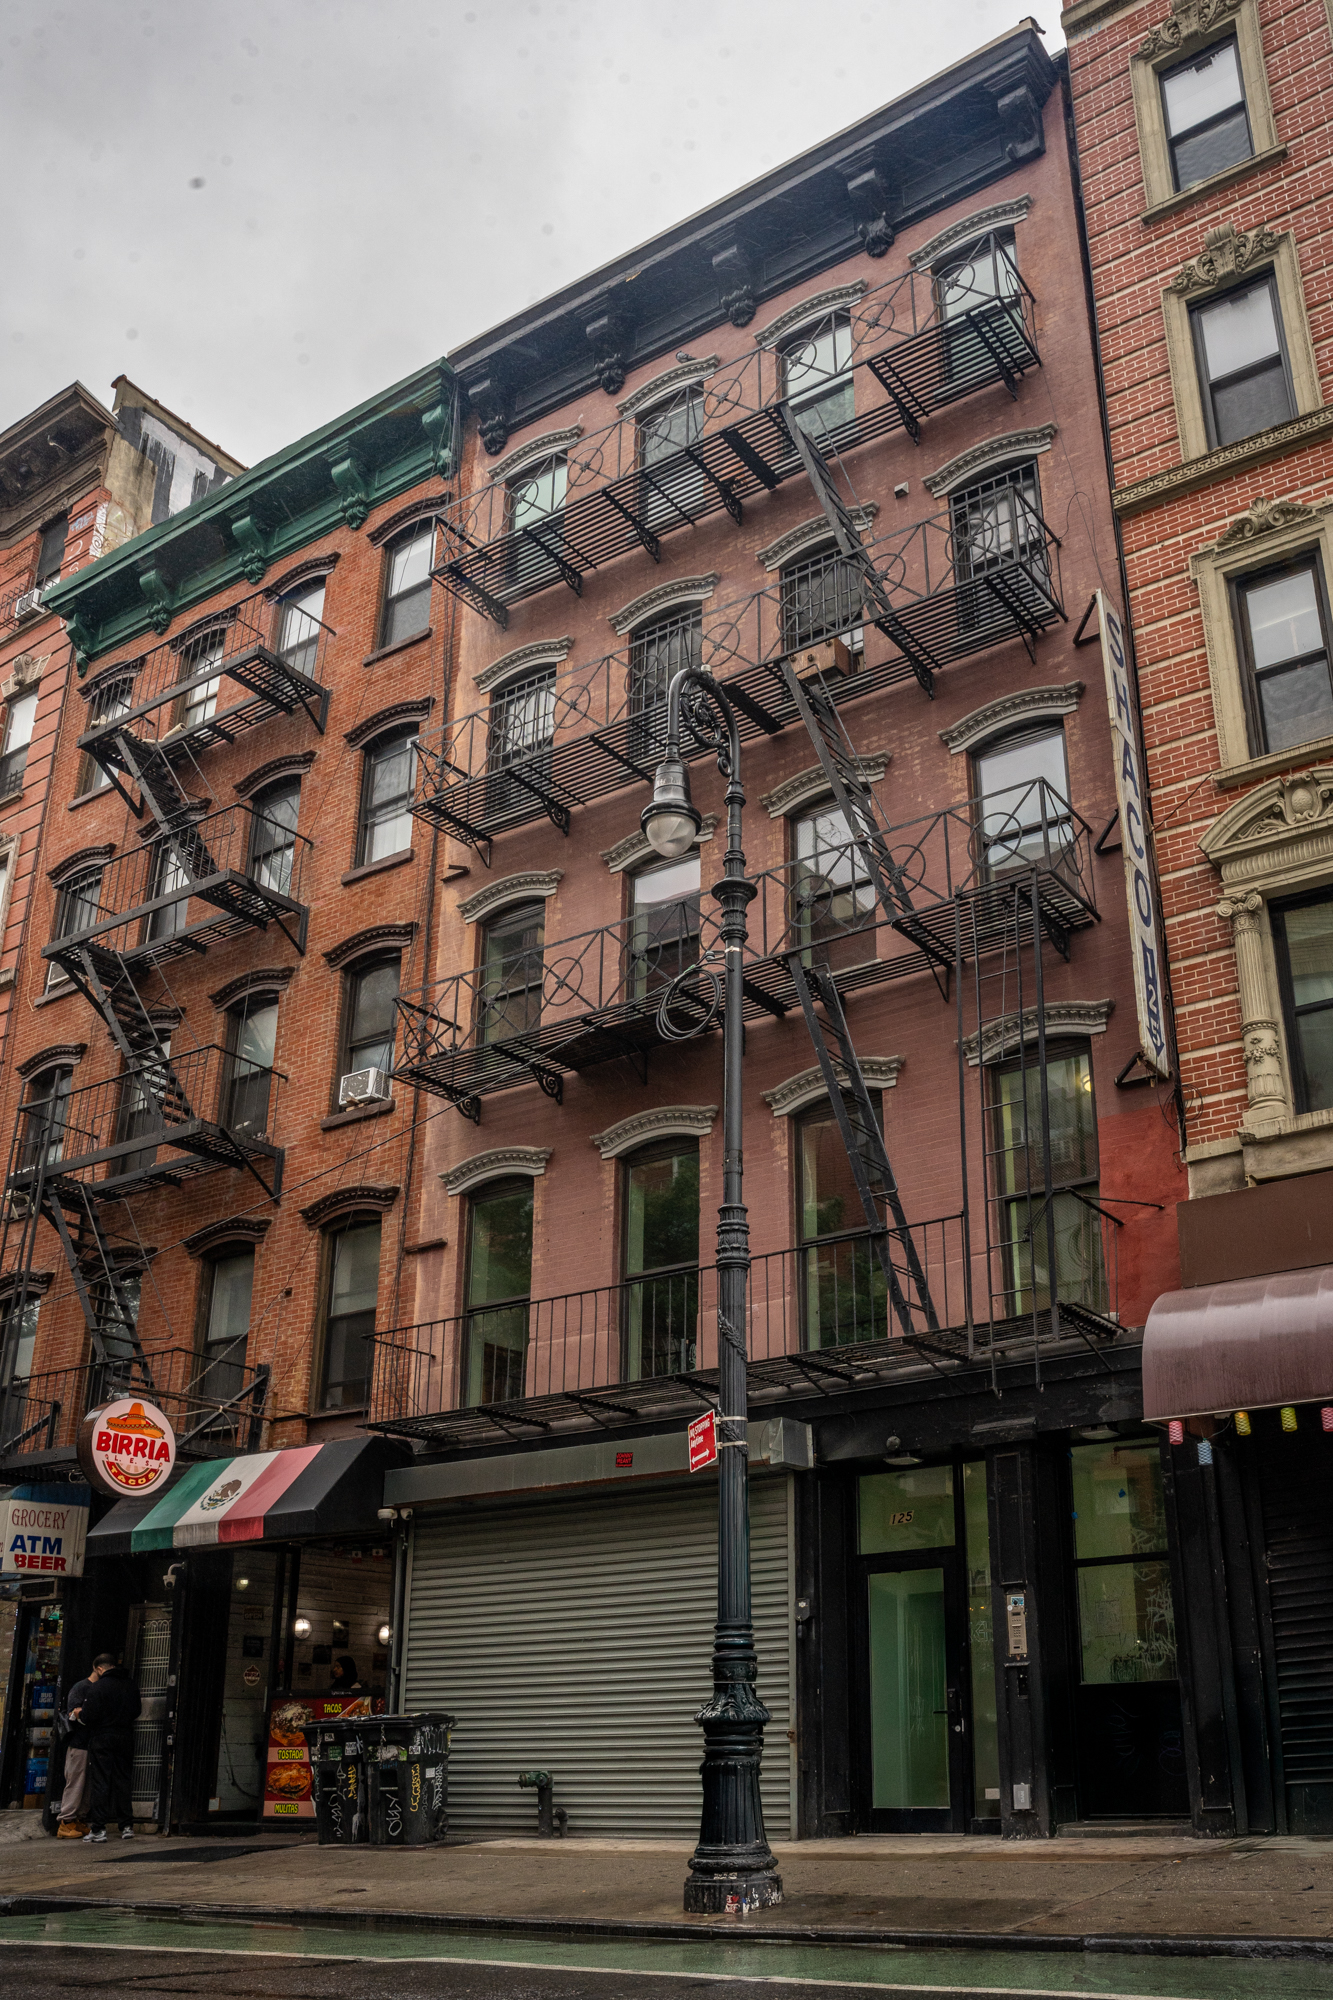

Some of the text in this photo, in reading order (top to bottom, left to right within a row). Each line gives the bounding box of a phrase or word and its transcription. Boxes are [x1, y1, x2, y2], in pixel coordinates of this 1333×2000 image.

[1106, 611, 1152, 928] SHACO
[1145, 950, 1163, 1048] 125
[695, 1418, 710, 1434] STOPPING
[96, 1431, 170, 1462] BIRRIA
[690, 1435, 704, 1448] Anytime
[110, 1464, 156, 1486] TACOS
[11, 1508, 71, 1530] GROCERY
[892, 1510, 913, 1525] 125
[9, 1534, 63, 1555] ATM
[14, 1554, 67, 1571] BEER
[323, 1703, 343, 1714] TACOS
[278, 1748, 304, 1760] TOSTADA
[274, 1803, 299, 1814] MULITAS
